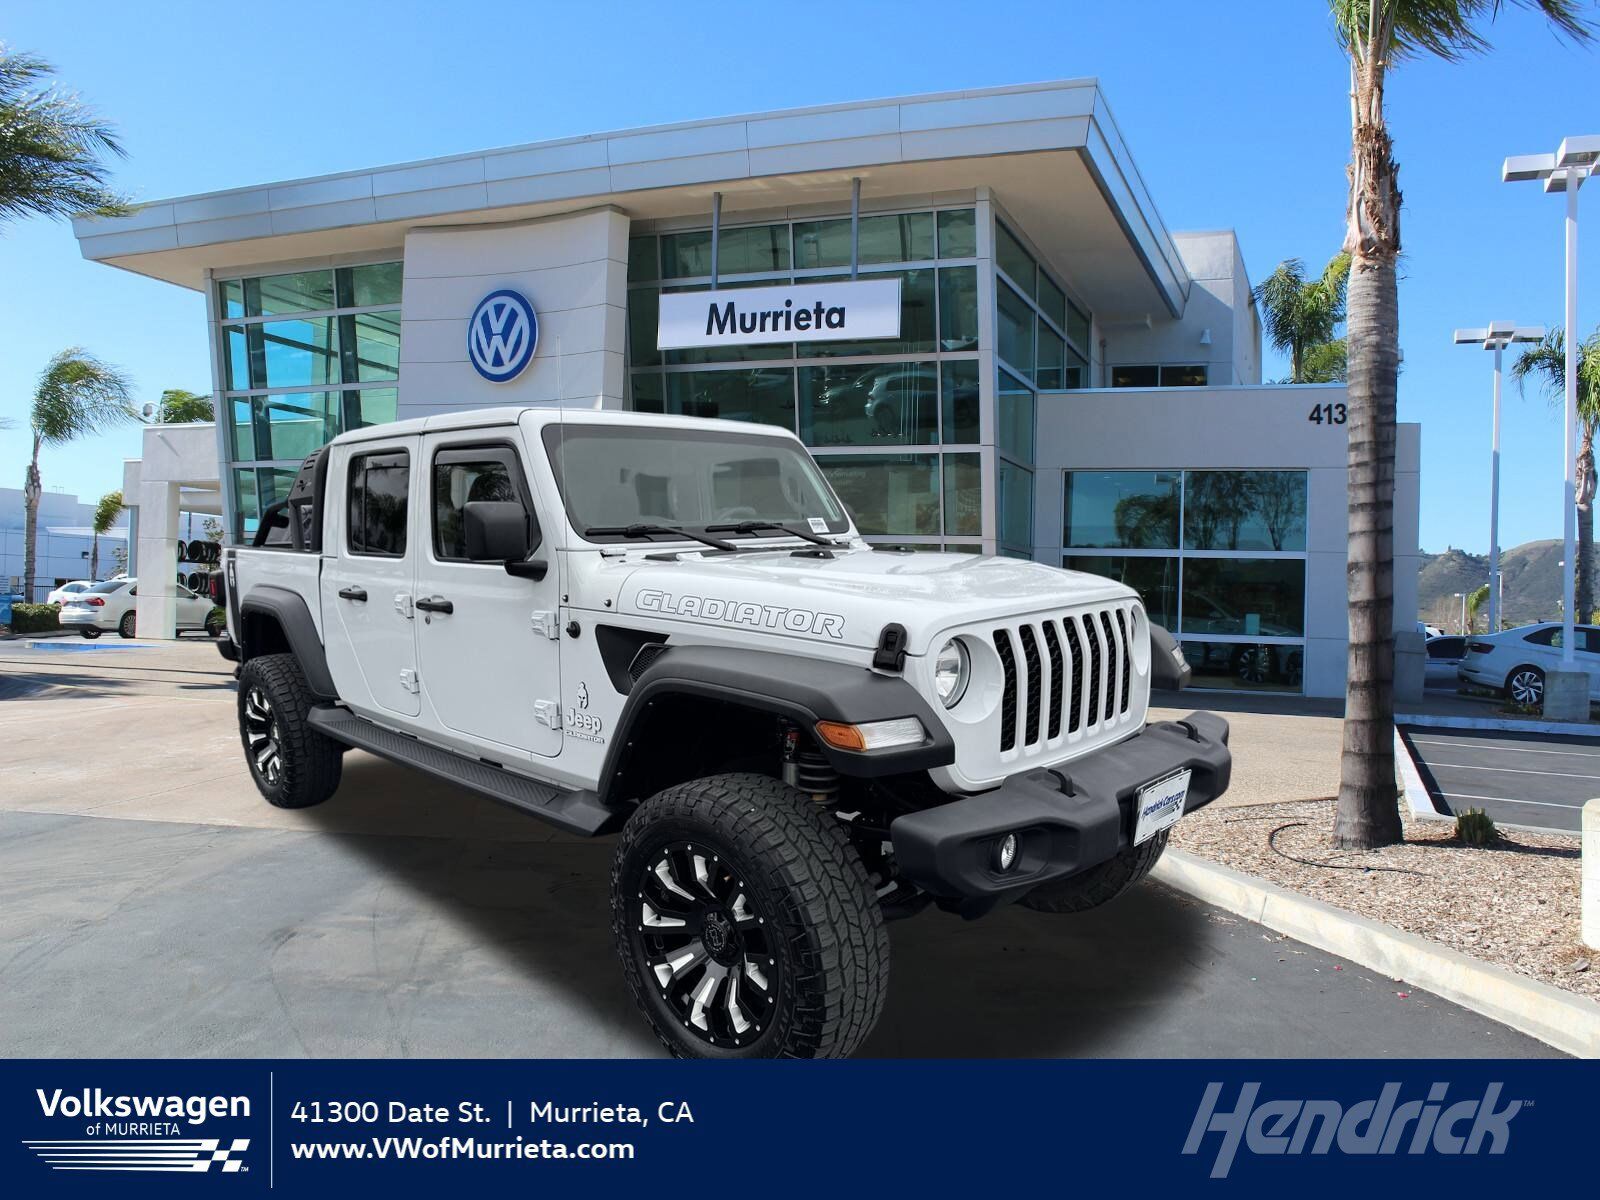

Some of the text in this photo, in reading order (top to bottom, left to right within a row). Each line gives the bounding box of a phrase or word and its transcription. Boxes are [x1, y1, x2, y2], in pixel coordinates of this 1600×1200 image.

[705, 297, 847, 336] Murrieta
[1308, 403, 1347, 425] 413
[635, 588, 845, 640] GLADIATOR
[566, 706, 602, 735] Jeep
